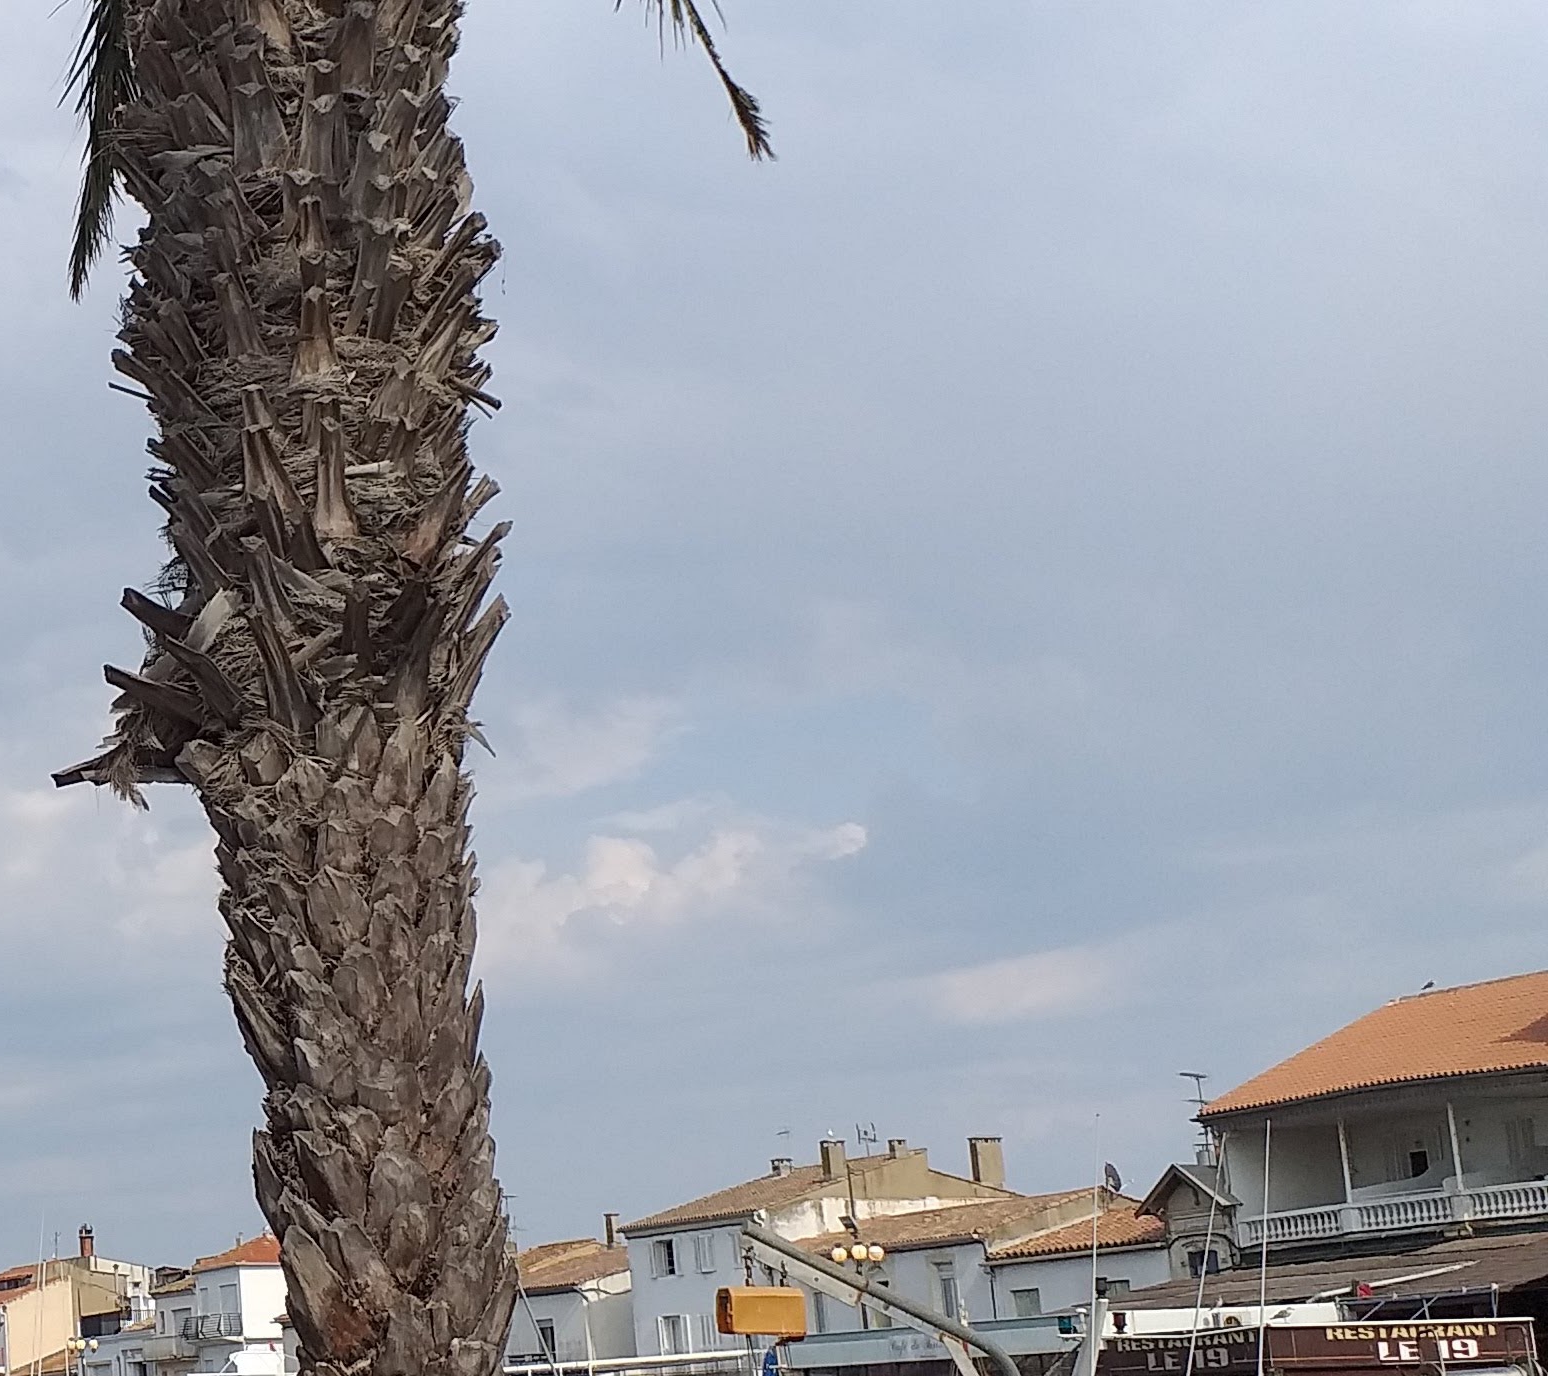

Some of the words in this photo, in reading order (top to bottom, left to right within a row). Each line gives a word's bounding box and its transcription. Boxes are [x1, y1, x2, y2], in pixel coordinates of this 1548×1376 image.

[1117, 1329, 1256, 1352] RESTAURANT
[1325, 1324, 1497, 1341] RESTAURANT
[1146, 1351, 1182, 1371] LE
[1194, 1347, 1229, 1369] 19
[1378, 1340, 1420, 1361] LE
[1439, 1338, 1479, 1360] 19
